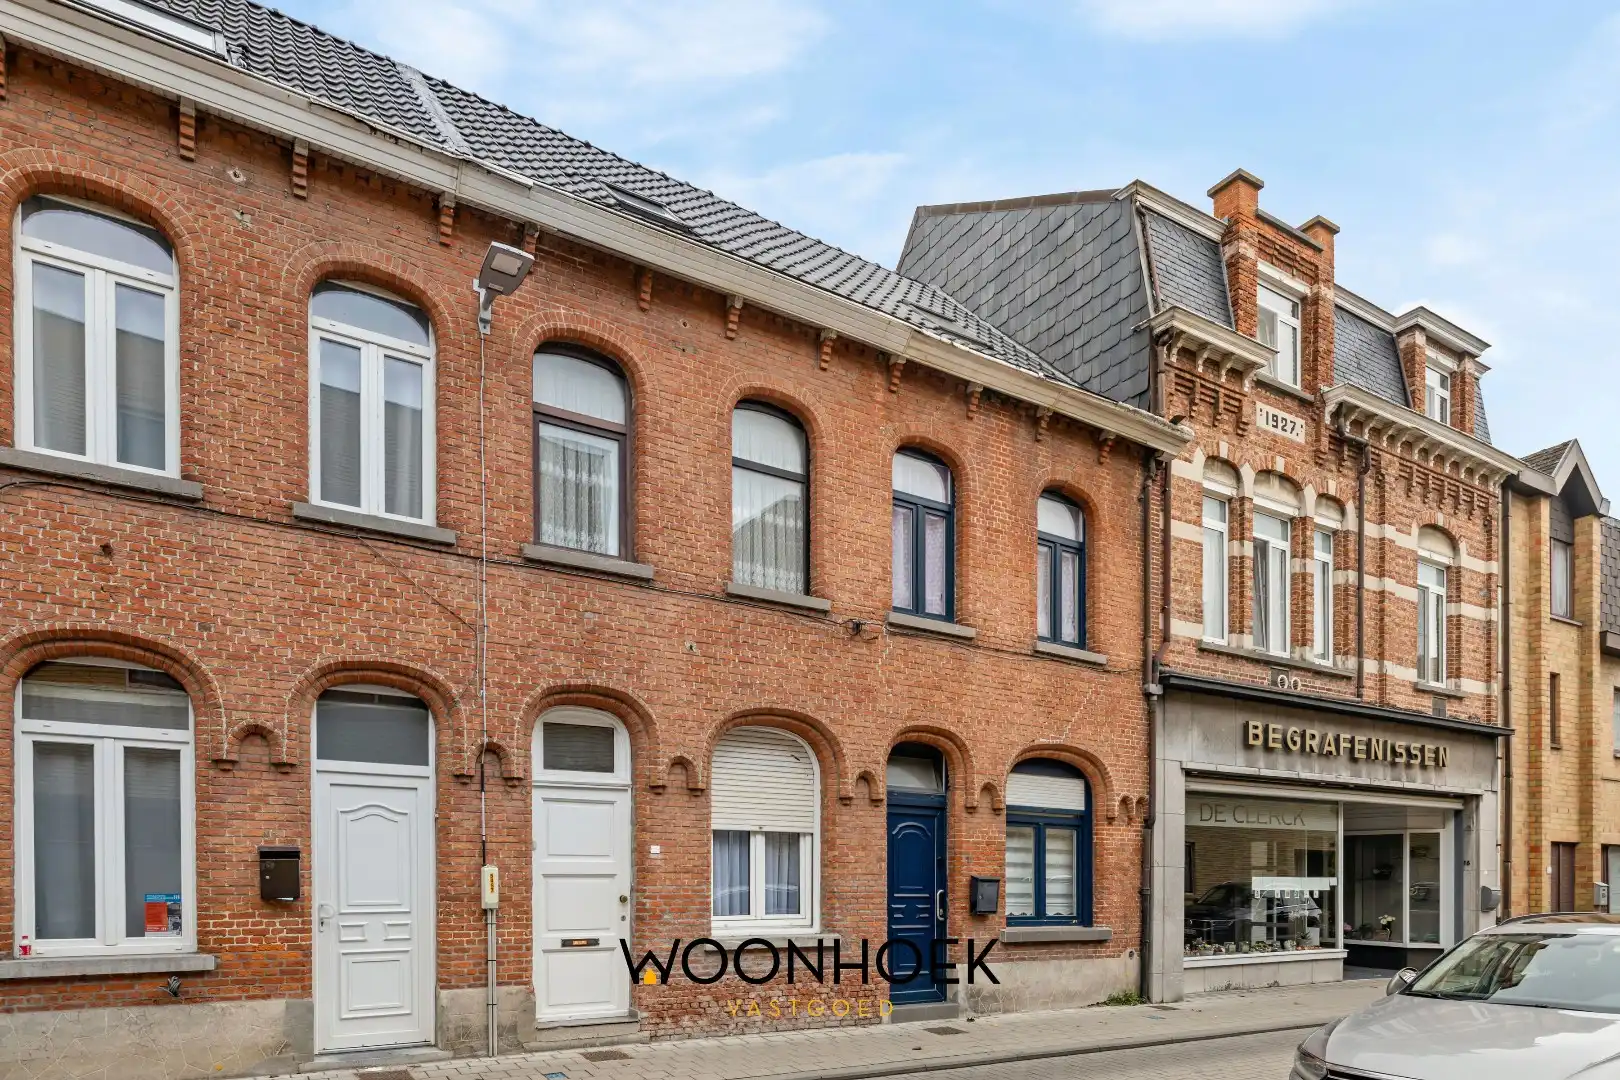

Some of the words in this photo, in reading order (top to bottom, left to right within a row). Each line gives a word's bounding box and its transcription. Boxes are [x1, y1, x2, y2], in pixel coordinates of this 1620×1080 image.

[1245, 720, 1449, 768] BEGRAFENISSEN
[1200, 803, 1227, 823] DE
[1233, 805, 1305, 827] CLERCK
